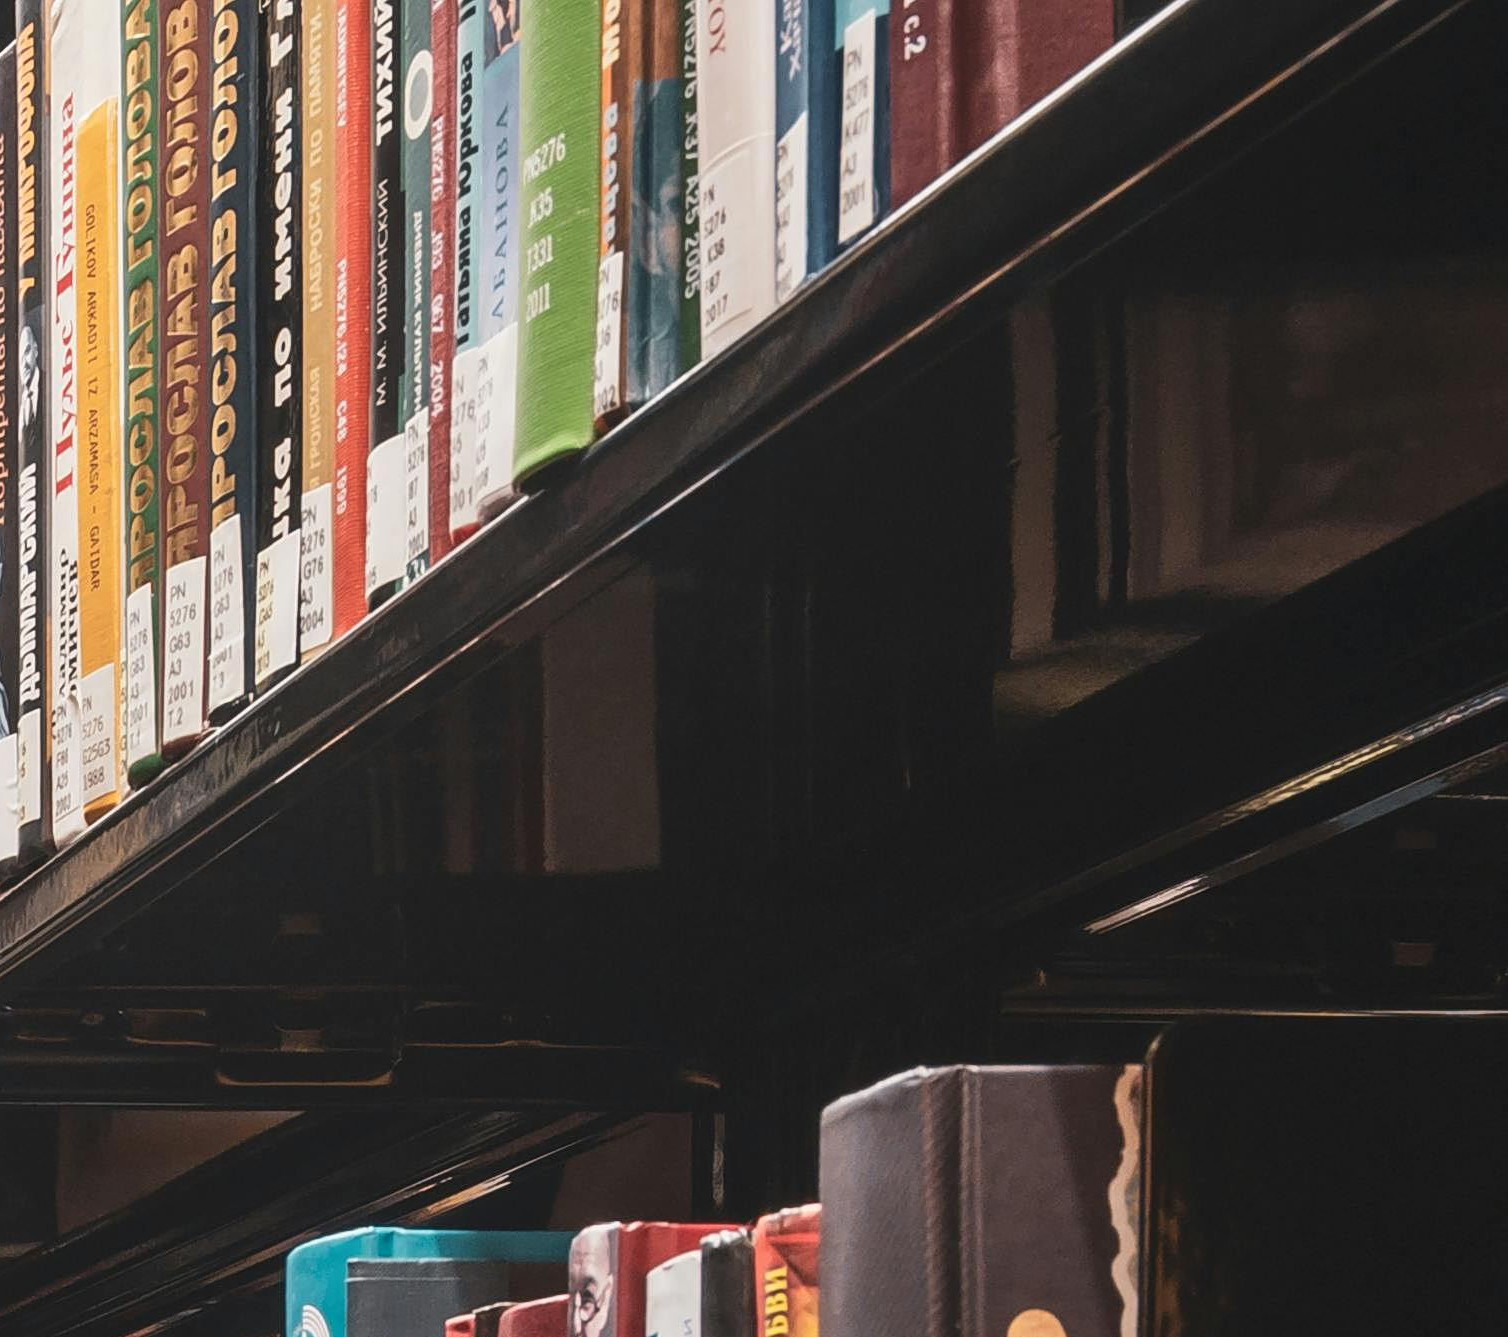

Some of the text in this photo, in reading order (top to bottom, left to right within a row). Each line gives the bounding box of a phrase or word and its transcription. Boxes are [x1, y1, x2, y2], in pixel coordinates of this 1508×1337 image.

[85, 203, 98, 279] GOLIKOV
[274, 87, 294, 408] имени по
[309, 127, 324, 314] НАБРОСКИ ПО
[376, 178, 390, 337] ИЛЬИНСКИЙ
[684, 239, 700, 299] 2005
[87, 376, 99, 397] IZ
[88, 409, 101, 496] ARZAMASA
[89, 526, 102, 592] GAIDAR
[169, 636, 192, 655] G63
[170, 605, 197, 629] 5276
[167, 685, 195, 706] 2001
